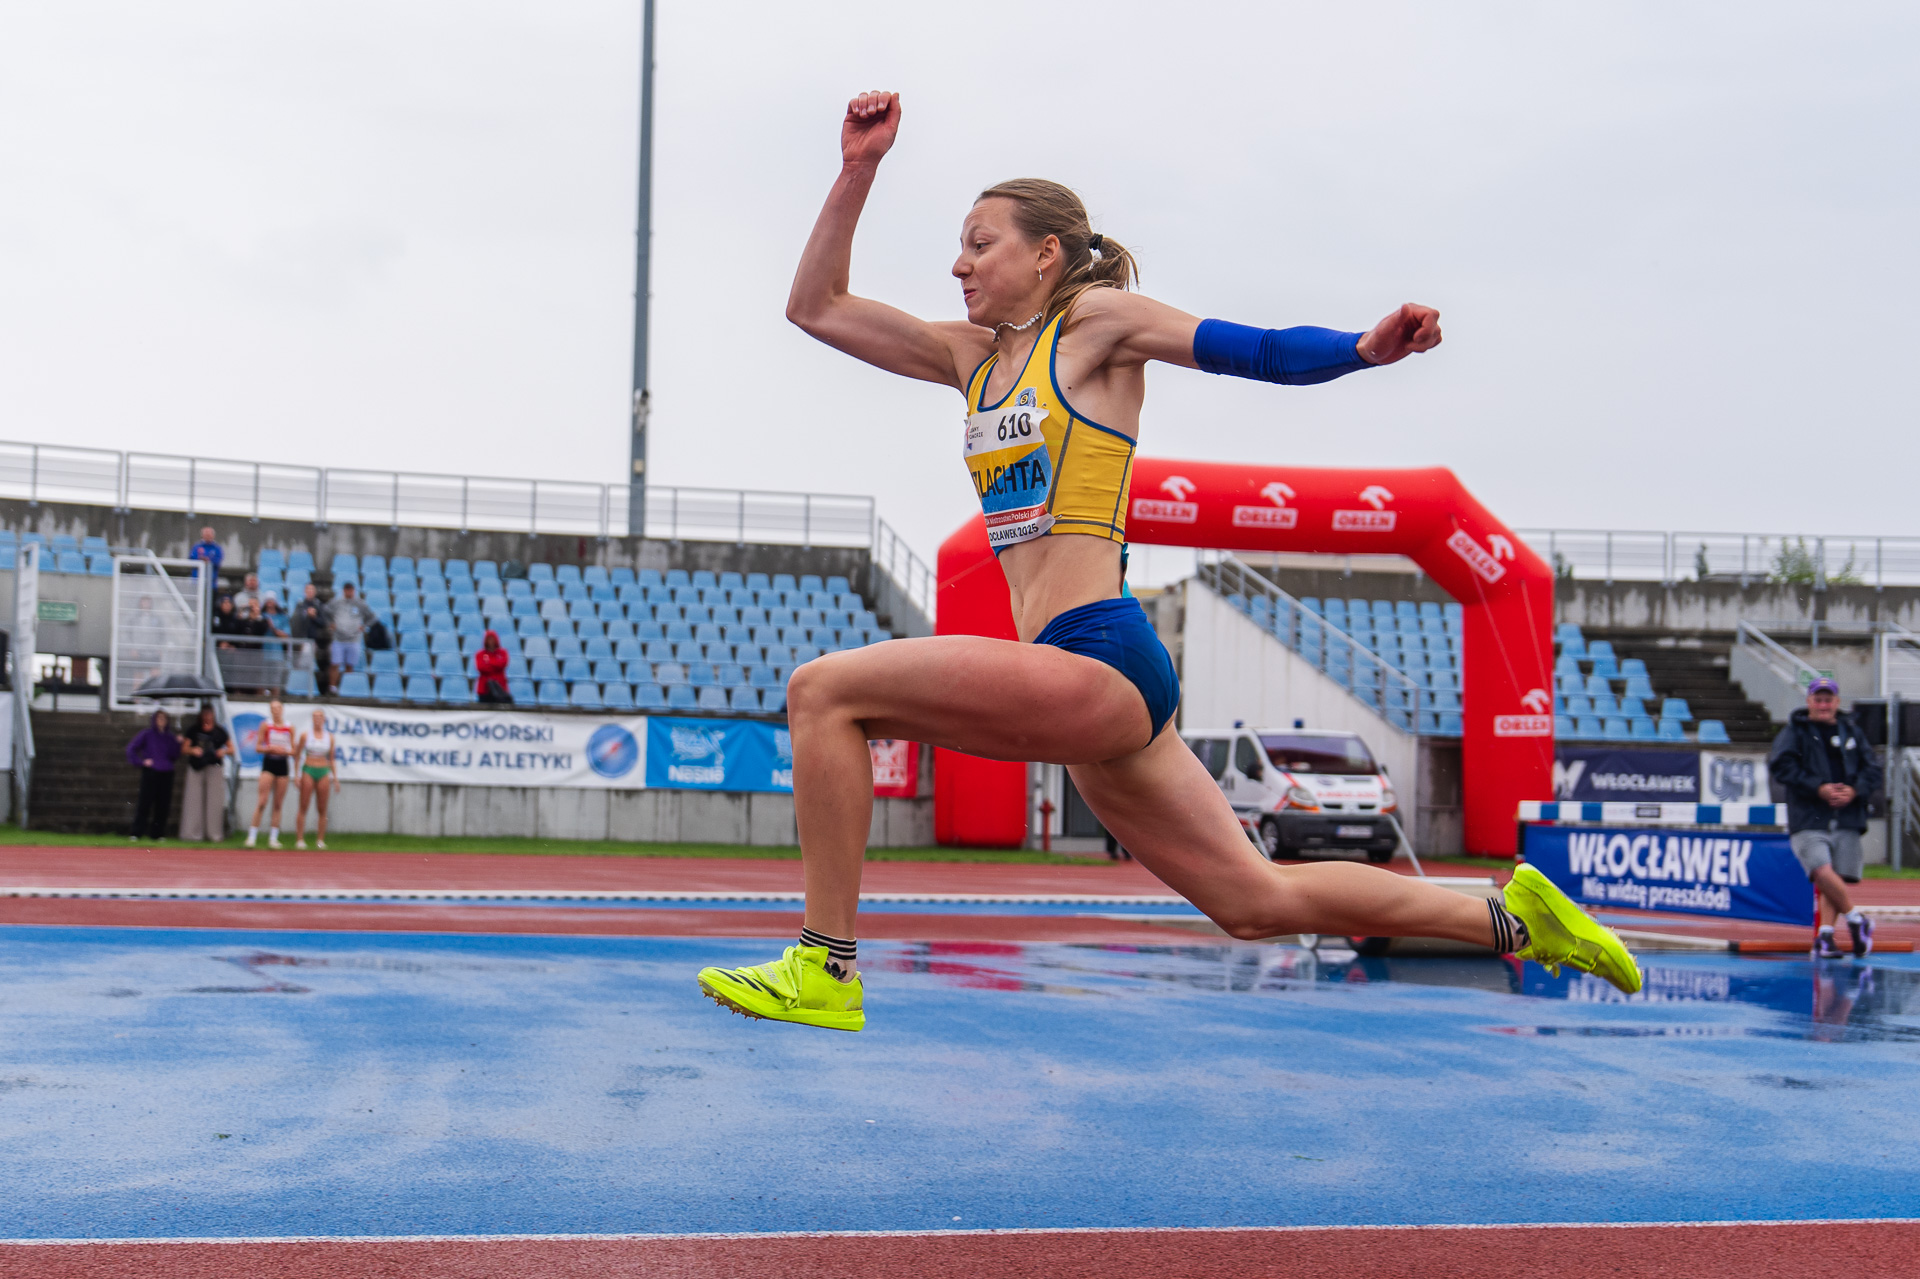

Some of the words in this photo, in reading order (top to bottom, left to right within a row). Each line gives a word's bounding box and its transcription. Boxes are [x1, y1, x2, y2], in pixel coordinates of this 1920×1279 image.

[997, 412, 1032, 442] 610
[971, 459, 1047, 499] ZLACHTA
[1011, 511, 1030, 521] Polski
[1137, 501, 1193, 520] ORLEN
[1237, 508, 1293, 526] ORLEN
[1336, 513, 1391, 529] ORLEN
[989, 528, 1018, 541] OCŁAWEK
[1017, 522, 1040, 537] 2025
[1452, 535, 1499, 578] ORLEN
[324, 717, 554, 742] UJAWSKO-POMORSKI
[334, 747, 386, 767] ĄZEK
[392, 749, 472, 767] LEKKIEJ
[479, 752, 572, 769] ATLETYKI
[1590, 772, 1696, 793] WŁOCŁAWEK
[1568, 832, 1752, 887] WŁOCŁAWEK
[1582, 876, 1605, 899] Nie
[1606, 878, 1648, 908] widzę
